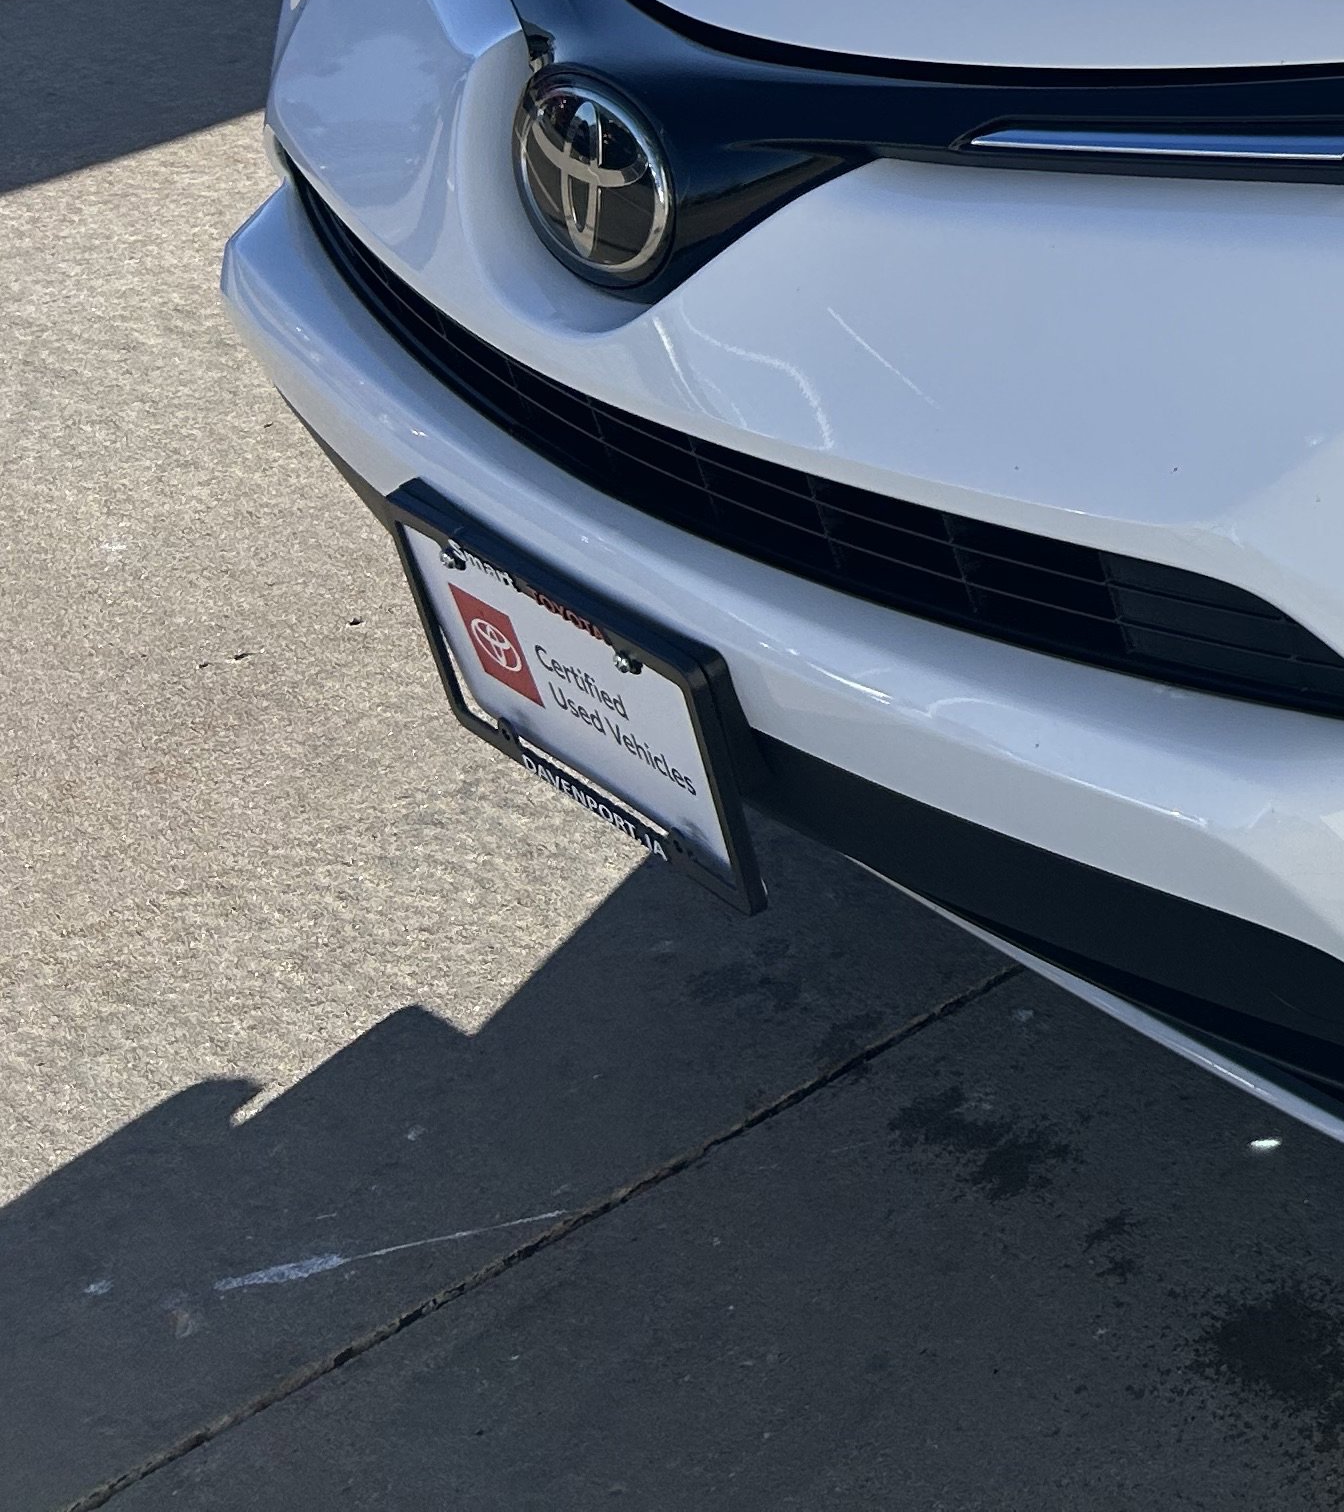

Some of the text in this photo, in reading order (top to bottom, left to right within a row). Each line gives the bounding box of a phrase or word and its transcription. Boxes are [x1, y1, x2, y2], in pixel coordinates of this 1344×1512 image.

[448, 538, 605, 640] Smart TOYOTA
[535, 644, 629, 721] Certified
[548, 681, 698, 796] Used Vehicles
[644, 833, 668, 862] IA
